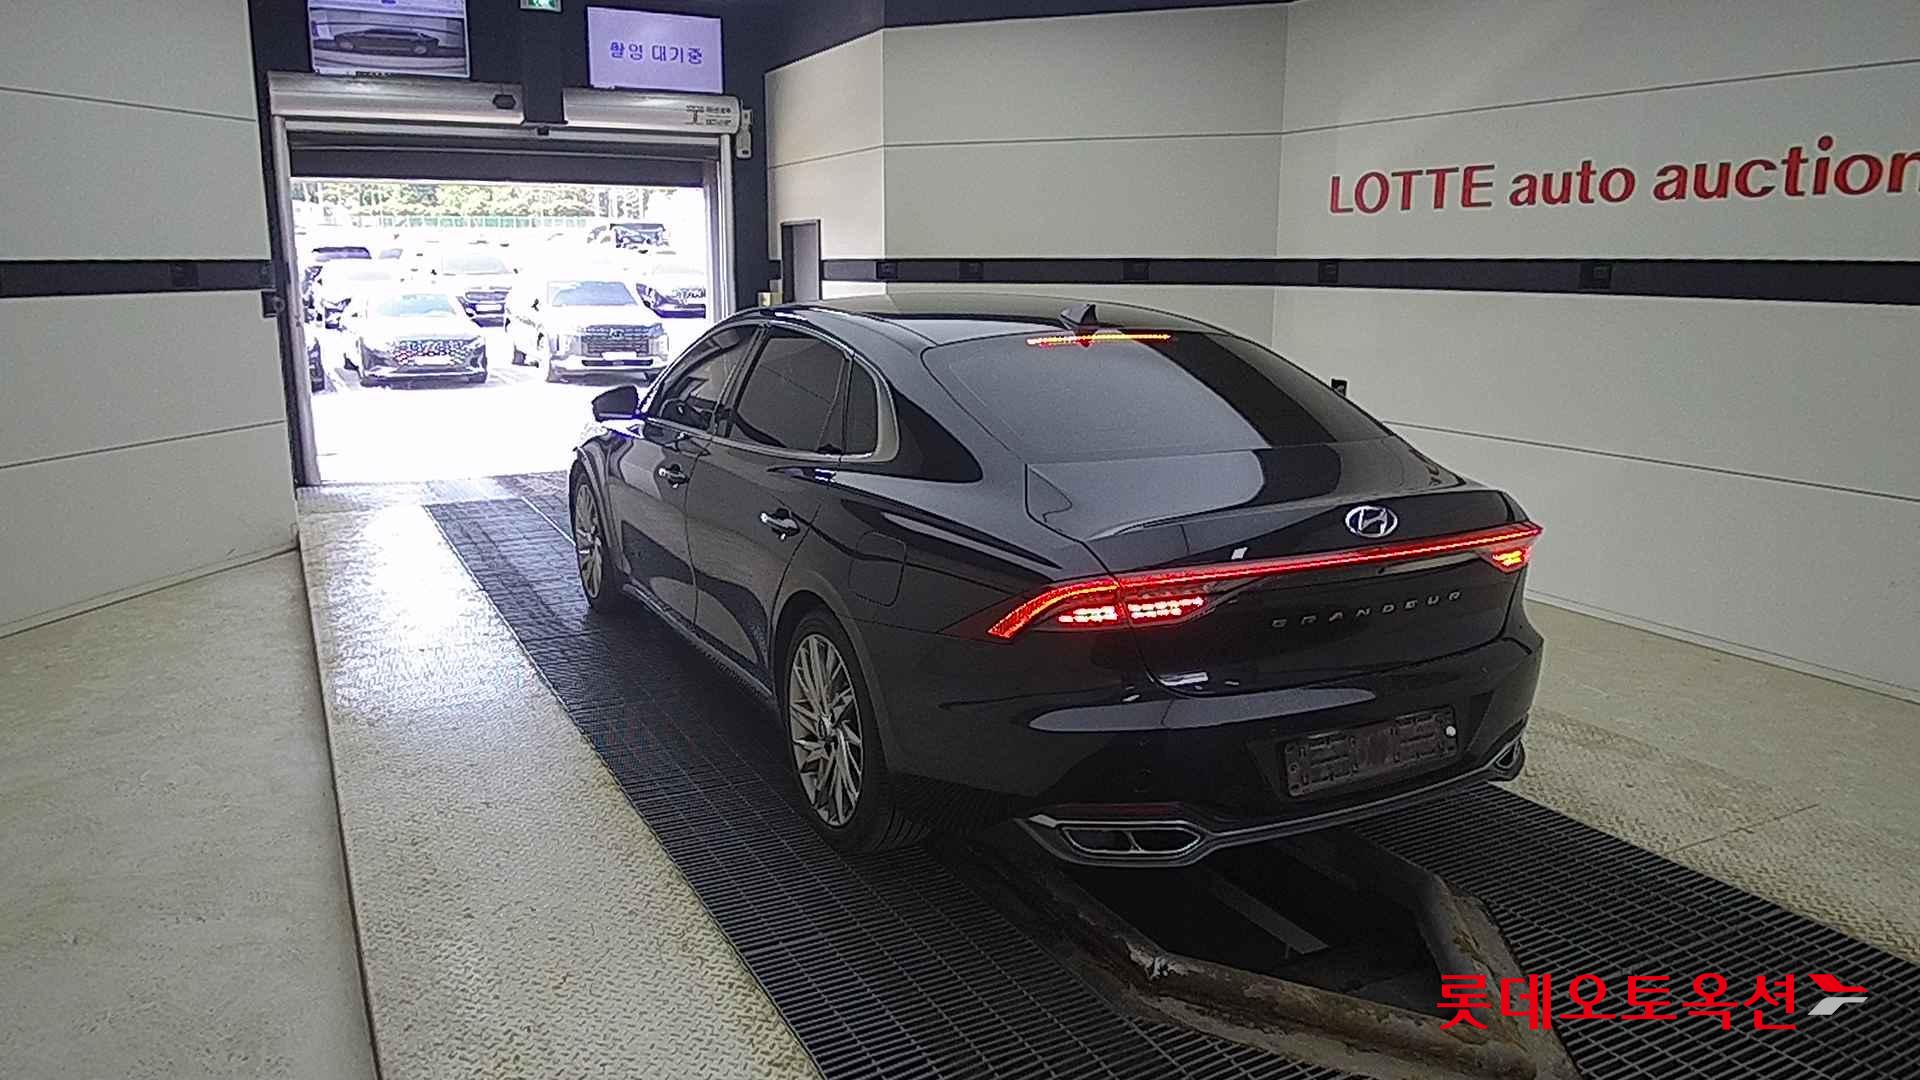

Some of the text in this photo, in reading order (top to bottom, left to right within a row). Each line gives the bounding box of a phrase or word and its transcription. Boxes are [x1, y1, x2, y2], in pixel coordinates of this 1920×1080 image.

[651, 45, 703, 65] 대기중
[1330, 135, 1920, 214] LOTTE auto auction
[1271, 591, 1461, 628] GRANDEUR
